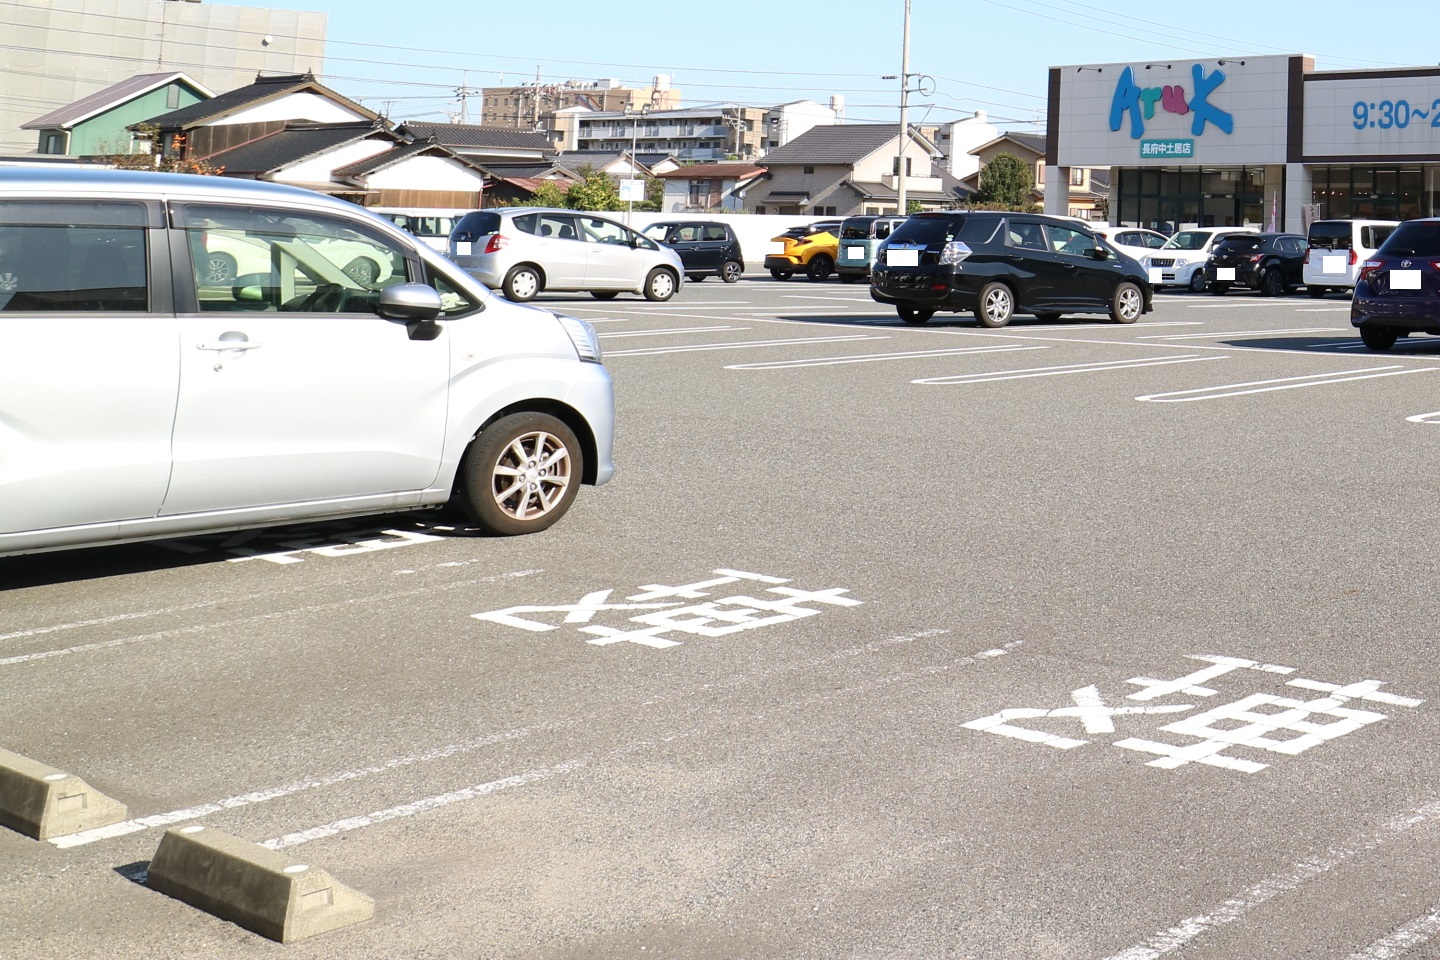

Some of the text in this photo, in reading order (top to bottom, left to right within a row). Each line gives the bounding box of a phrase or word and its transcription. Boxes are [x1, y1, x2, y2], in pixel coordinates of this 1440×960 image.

[1142, 143, 1191, 155] 長府中土居店
